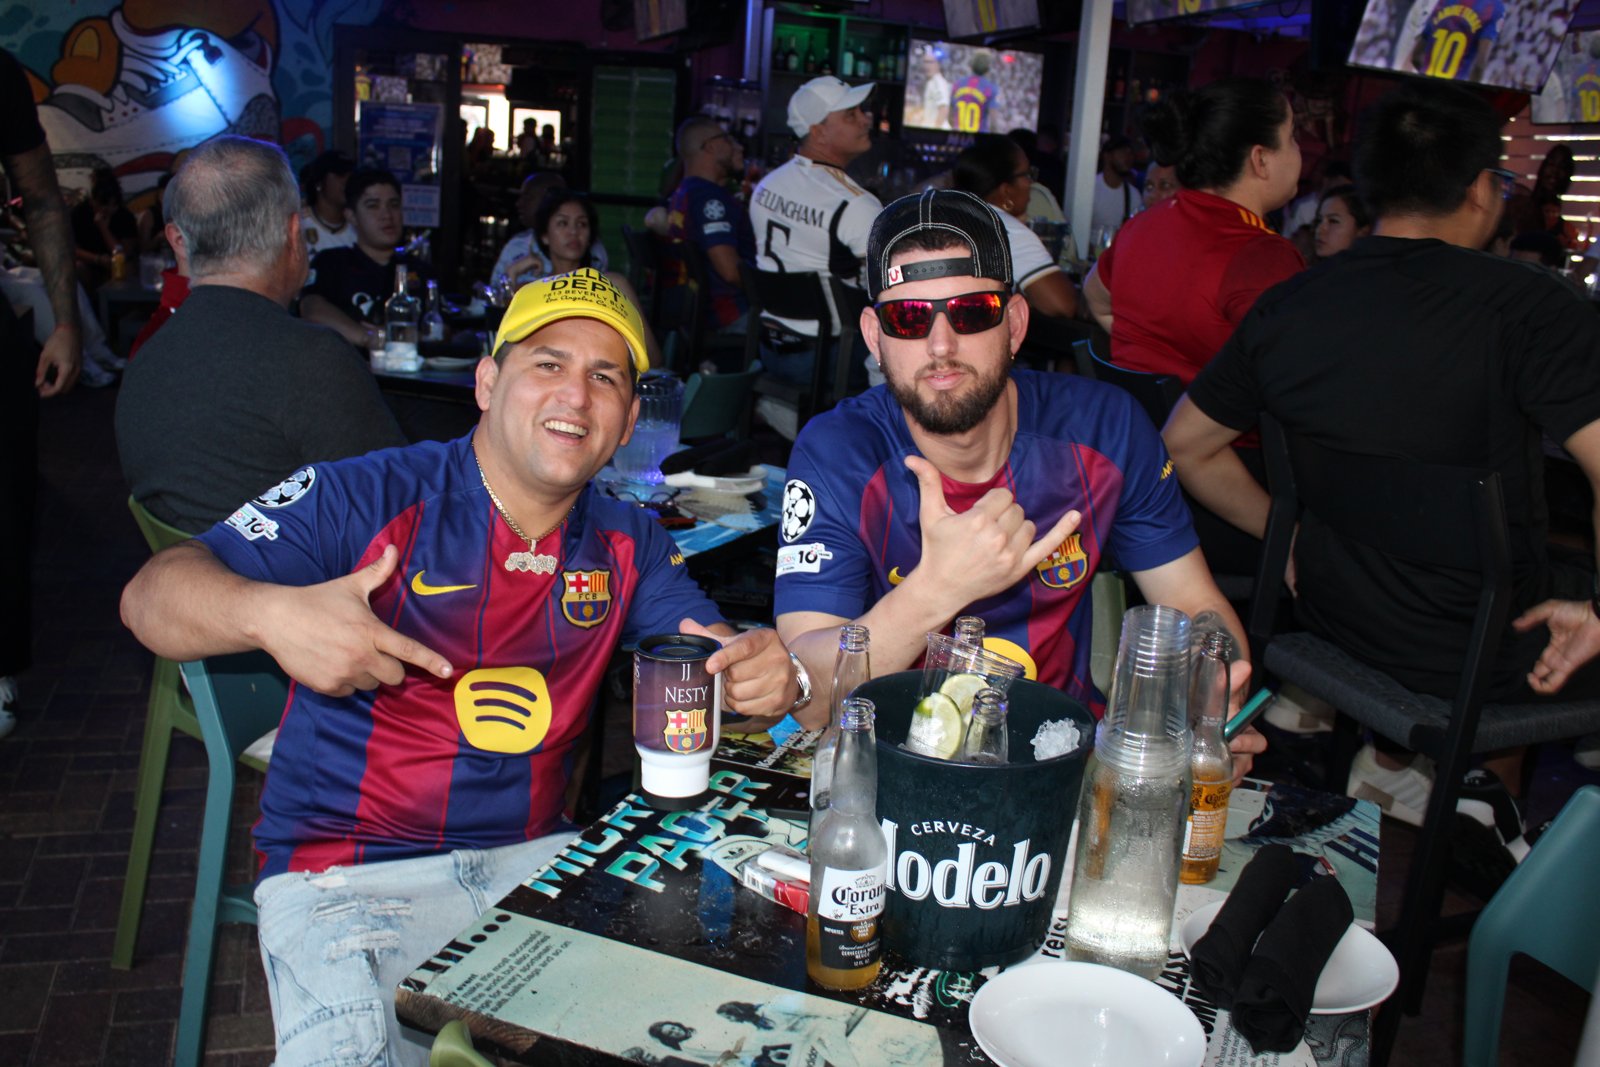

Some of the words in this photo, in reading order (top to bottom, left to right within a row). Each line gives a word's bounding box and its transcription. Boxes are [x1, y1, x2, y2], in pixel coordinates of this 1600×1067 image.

[1424, 28, 1468, 80] 10
[956, 101, 982, 133] 10
[798, 550, 819, 564] 10
[681, 663, 691, 682] JJ
[910, 820, 996, 848] CERVEZA
[849, 901, 880, 916] Extra
